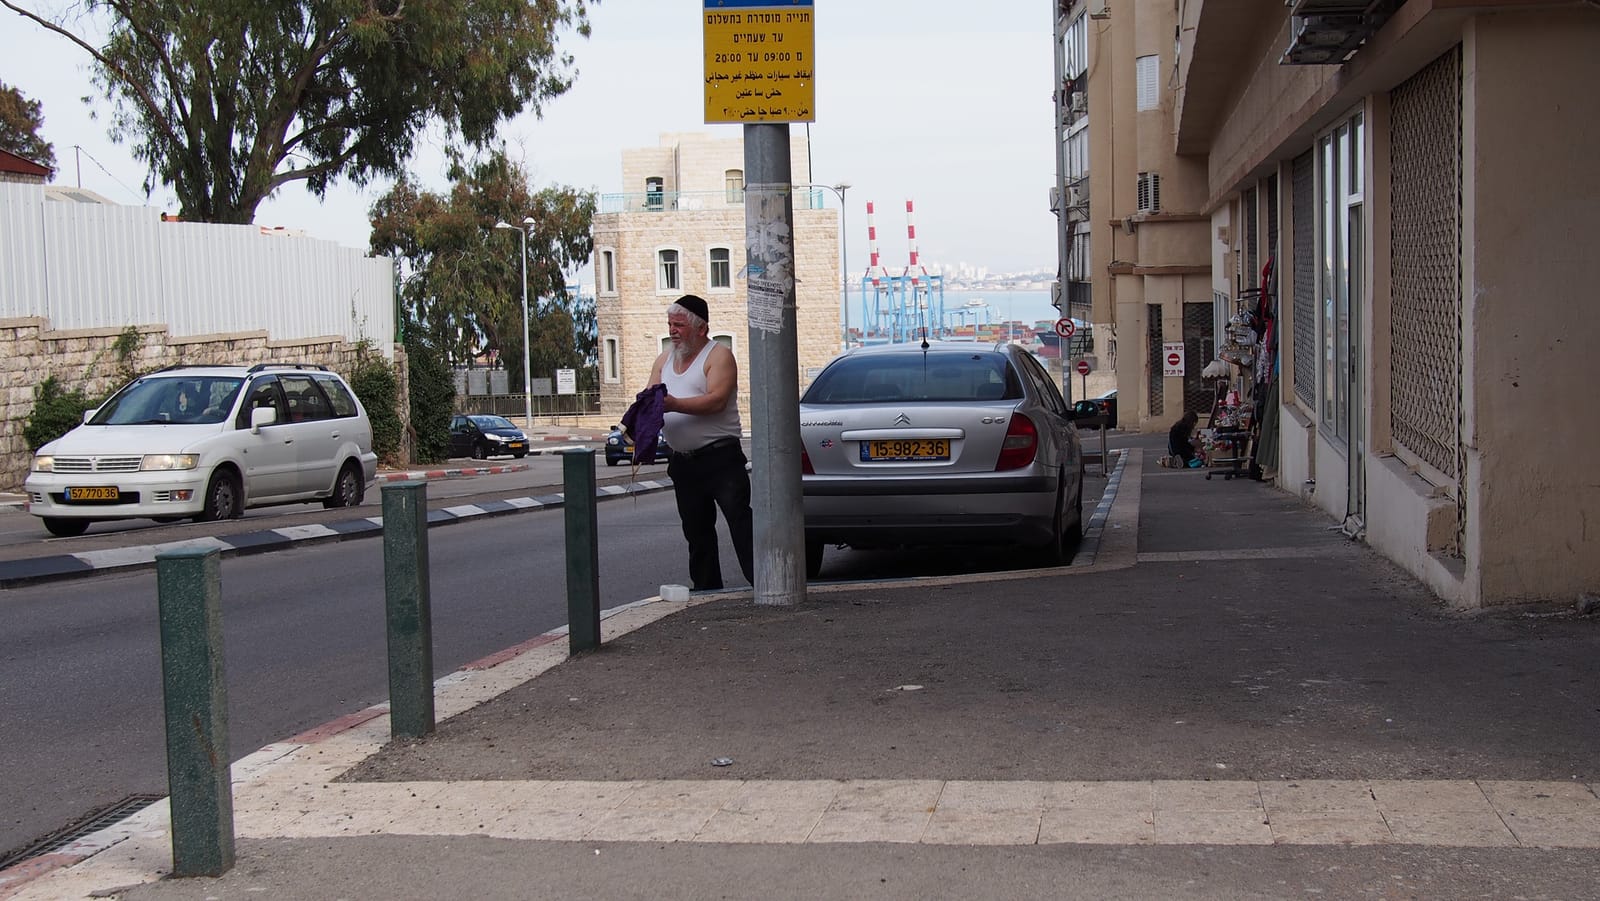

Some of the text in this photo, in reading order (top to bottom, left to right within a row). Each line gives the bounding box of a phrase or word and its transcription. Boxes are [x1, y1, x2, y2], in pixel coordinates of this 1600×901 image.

[707, 13, 810, 24] חנייה מוסדרת בתשלום
[733, 32, 783, 43] עד שעתיים
[715, 53, 742, 63] 20:00
[747, 53, 759, 62] עד
[764, 52, 791, 62] 09:00
[873, 440, 945, 457] 15-982-36
